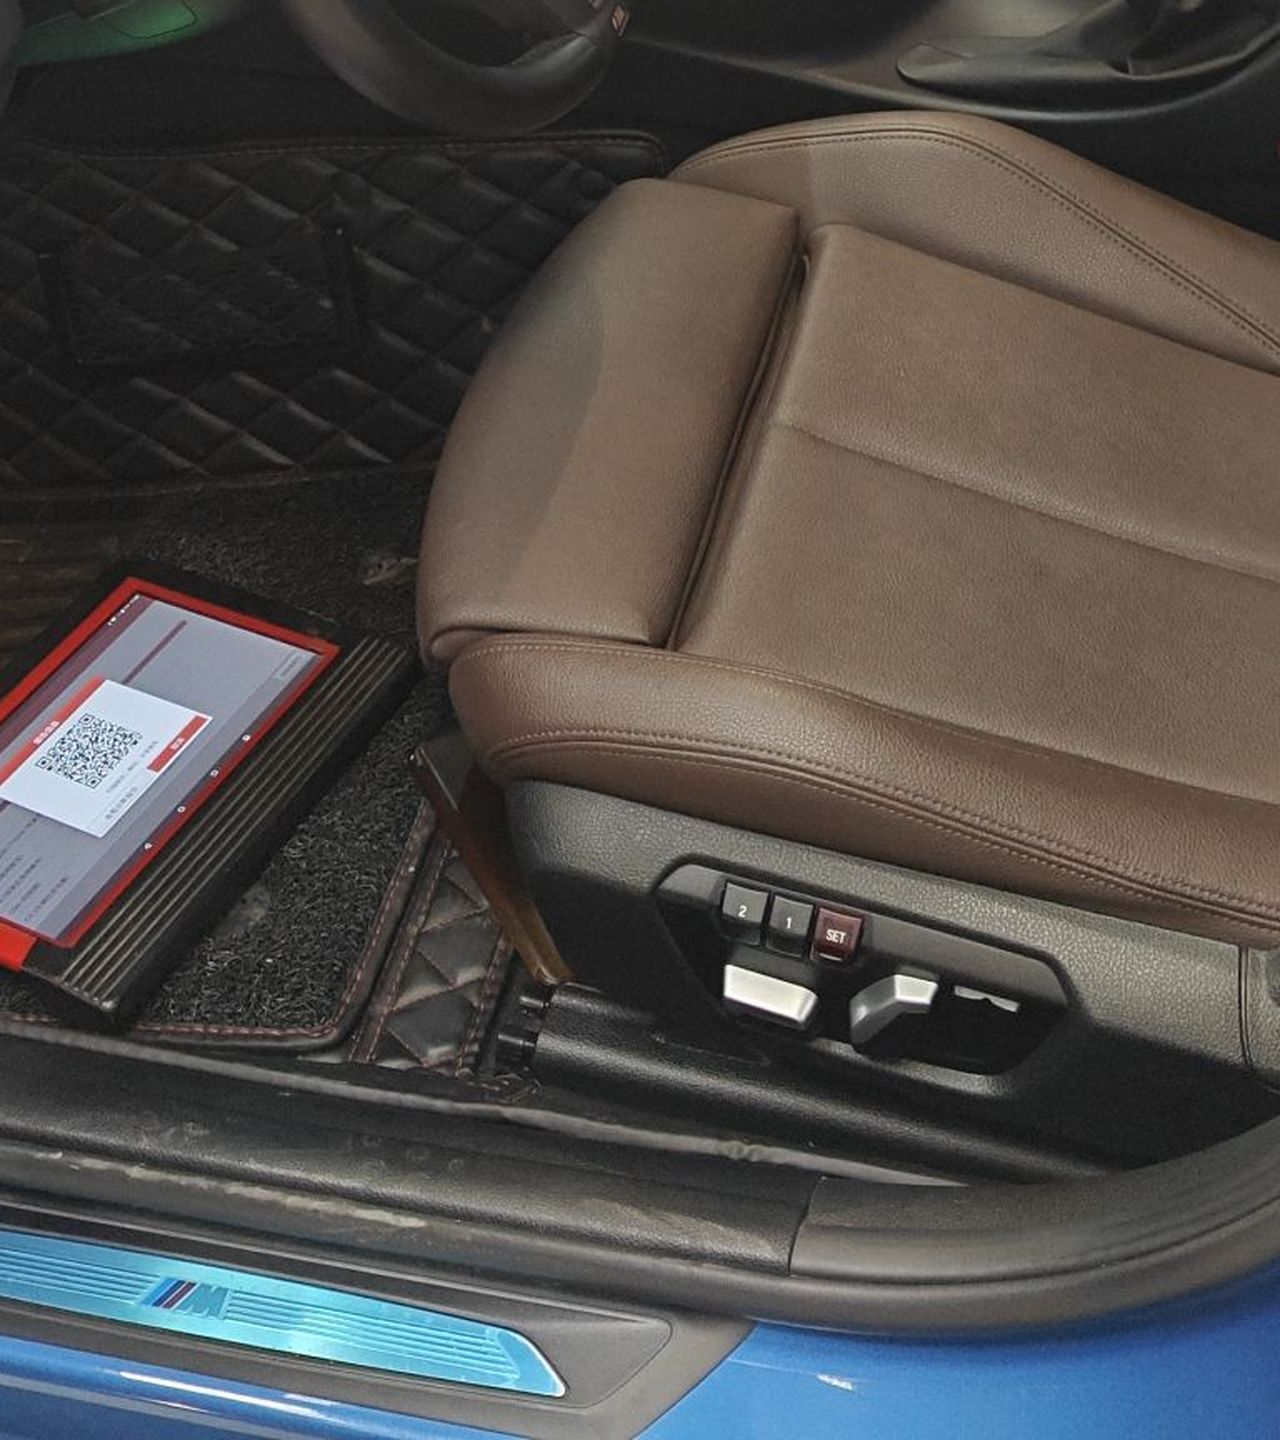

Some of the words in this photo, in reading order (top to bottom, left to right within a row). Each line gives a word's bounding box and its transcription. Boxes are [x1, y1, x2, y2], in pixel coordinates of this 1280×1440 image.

[738, 905, 747, 917] 2
[786, 917, 792, 929] 1
[826, 929, 847, 943] SET
